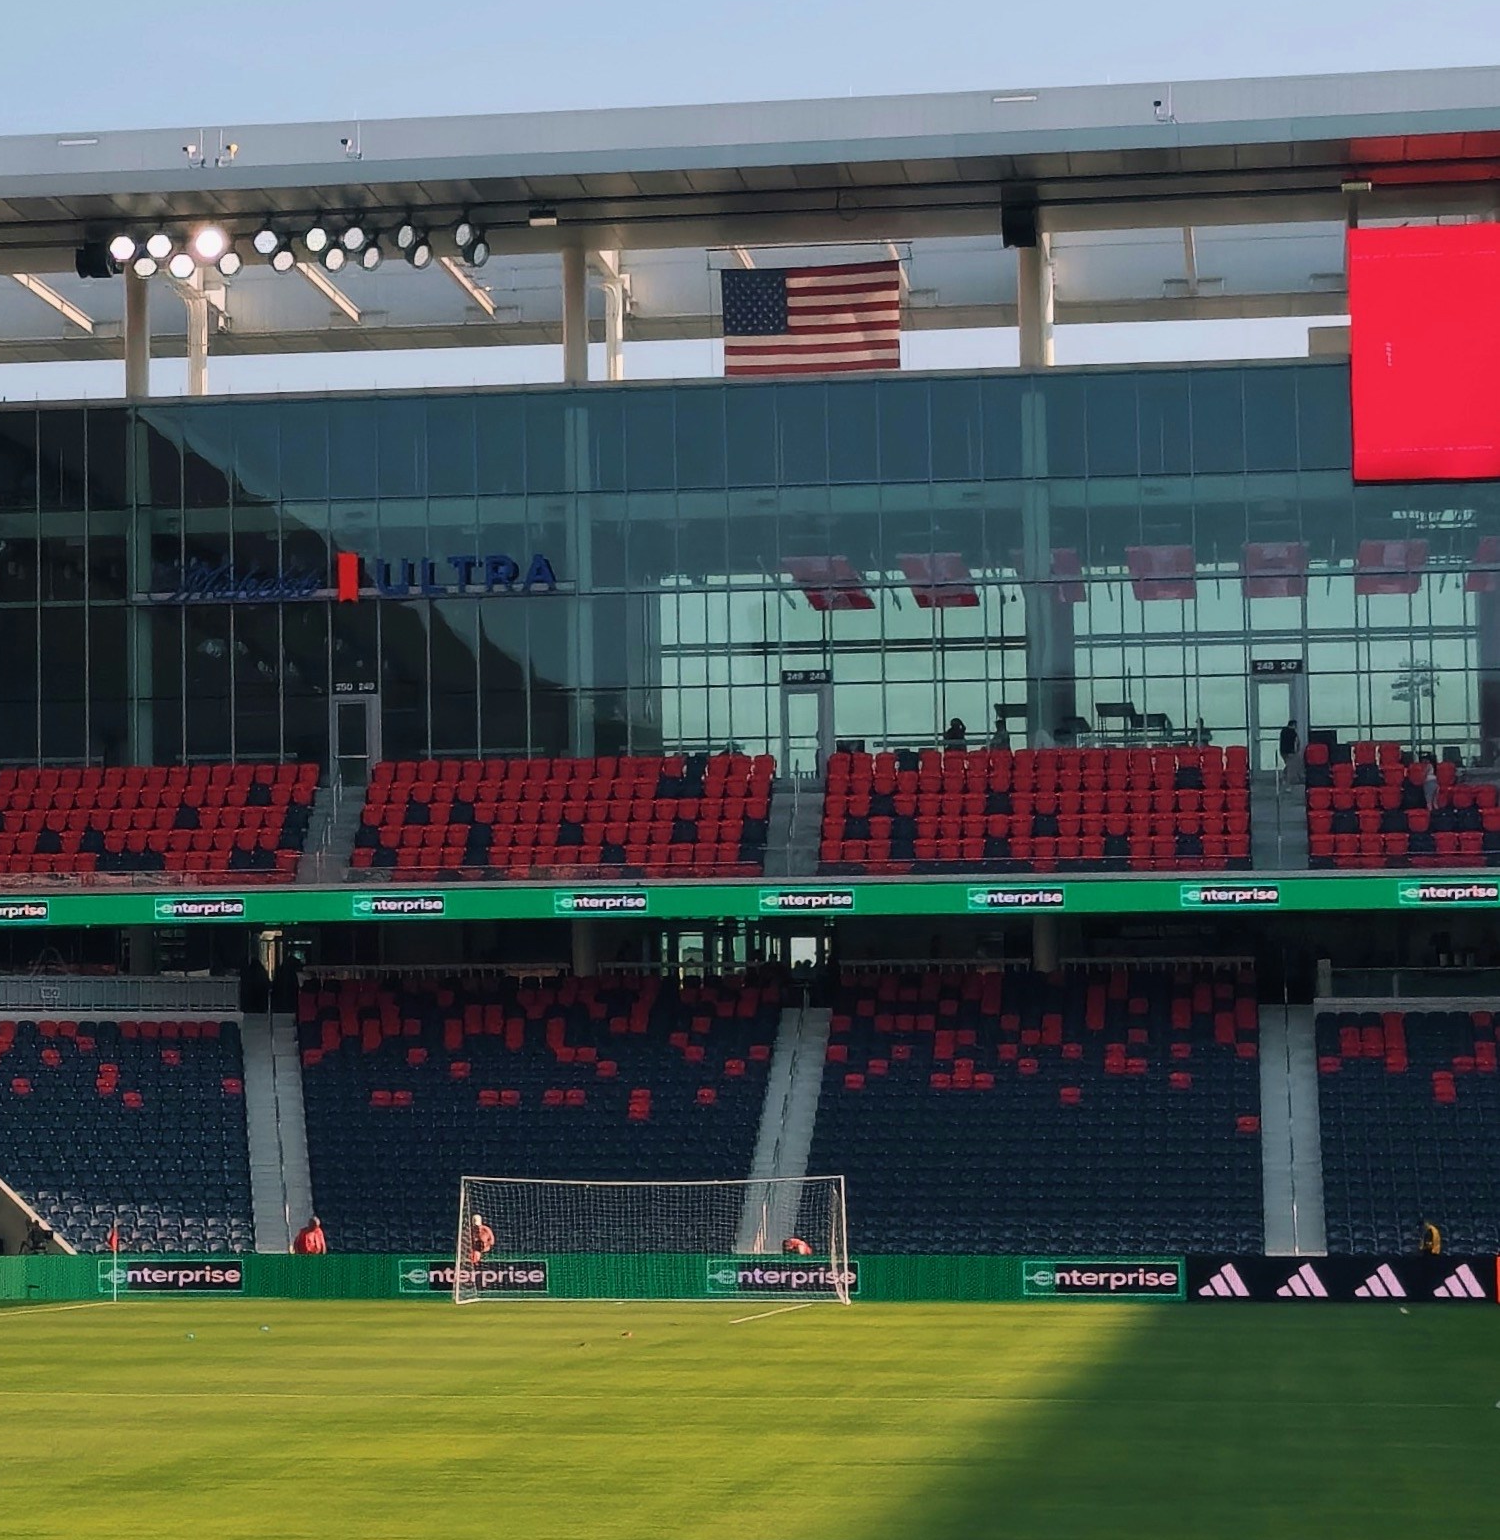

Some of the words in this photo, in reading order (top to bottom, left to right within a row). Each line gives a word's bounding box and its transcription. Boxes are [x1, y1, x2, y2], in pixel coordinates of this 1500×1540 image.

[376, 553, 557, 595] ULTRA
[765, 893, 853, 907] enterprise
[973, 891, 1063, 906] enterprise
[1187, 888, 1278, 903] enterprise
[1405, 885, 1498, 900] enterprise
[161, 901, 244, 916] enterprise
[360, 898, 443, 912] enterprise
[561, 895, 646, 909] enterprise
[110, 1265, 241, 1288] enterprise
[409, 1265, 545, 1288] enterprise
[719, 1265, 857, 1288] enterprise
[1033, 1266, 1178, 1290] enterprise
